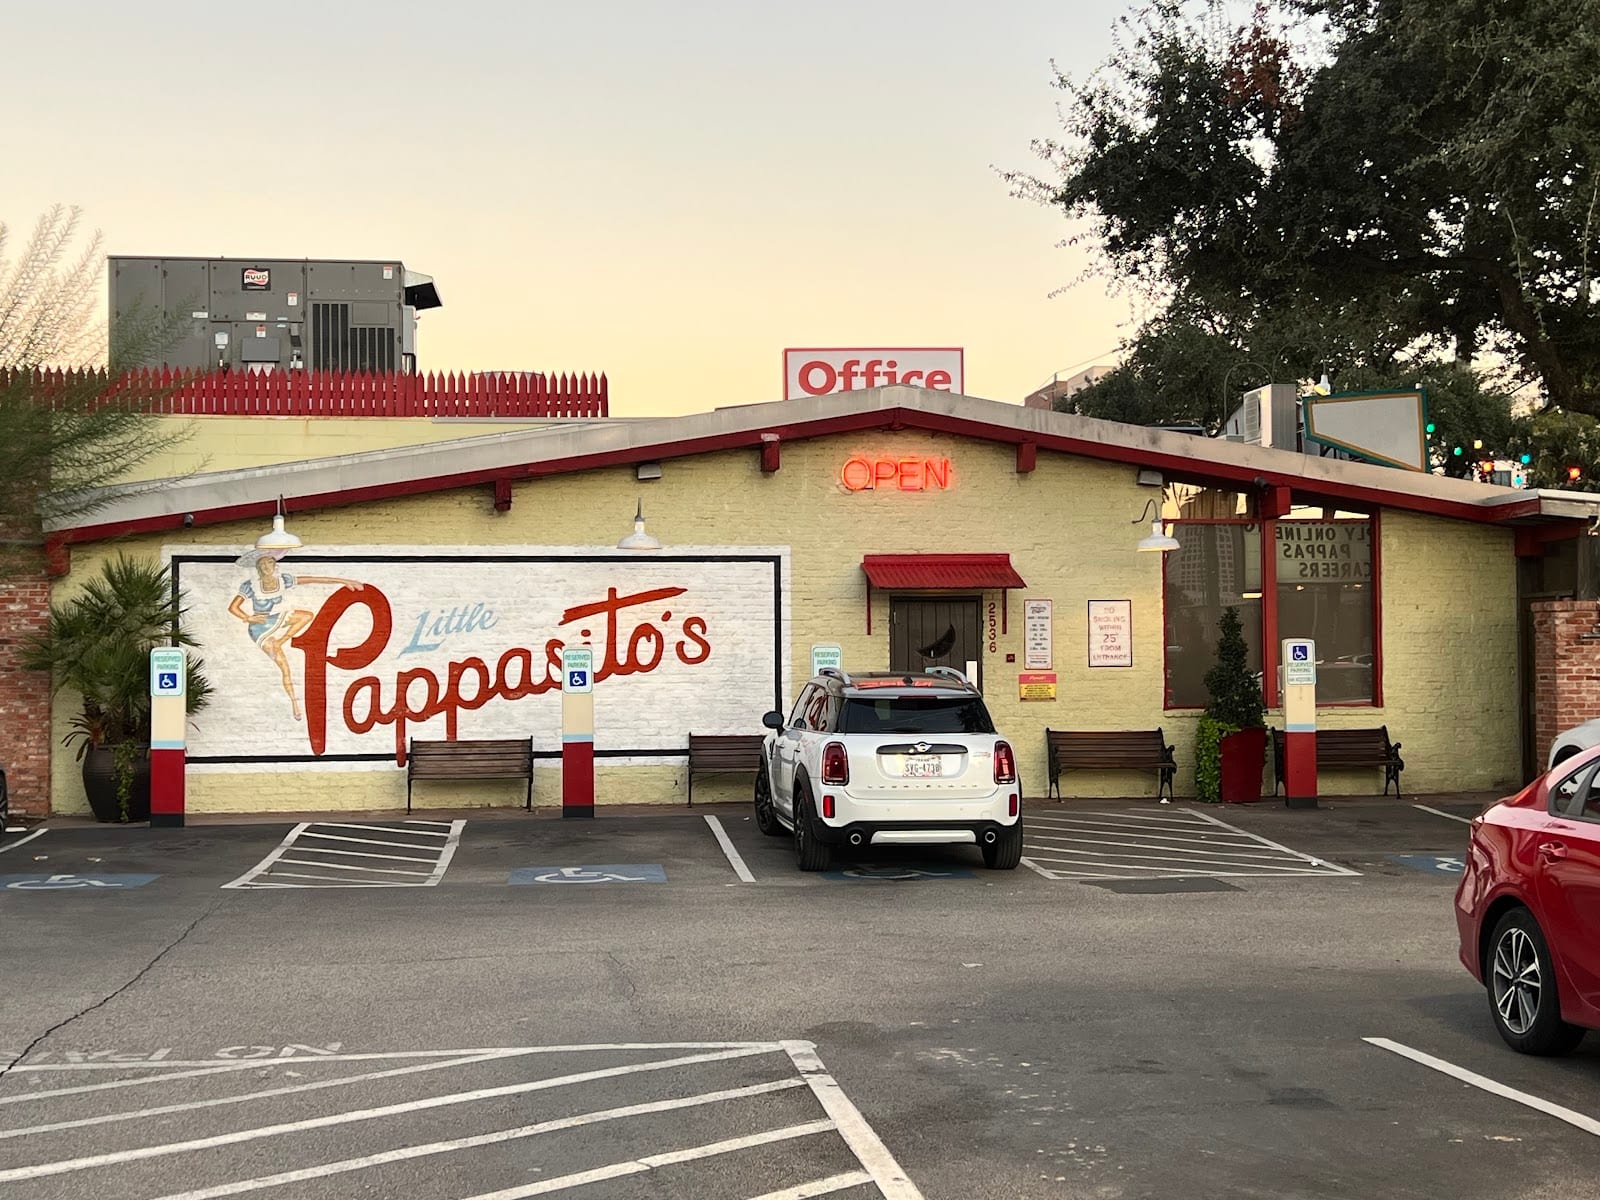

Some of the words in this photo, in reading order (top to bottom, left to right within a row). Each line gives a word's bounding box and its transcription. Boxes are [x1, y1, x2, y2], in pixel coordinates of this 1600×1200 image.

[798, 359, 952, 396] Office
[841, 456, 949, 491] OPEN
[397, 602, 499, 659] Little
[988, 602, 997, 653] 2536
